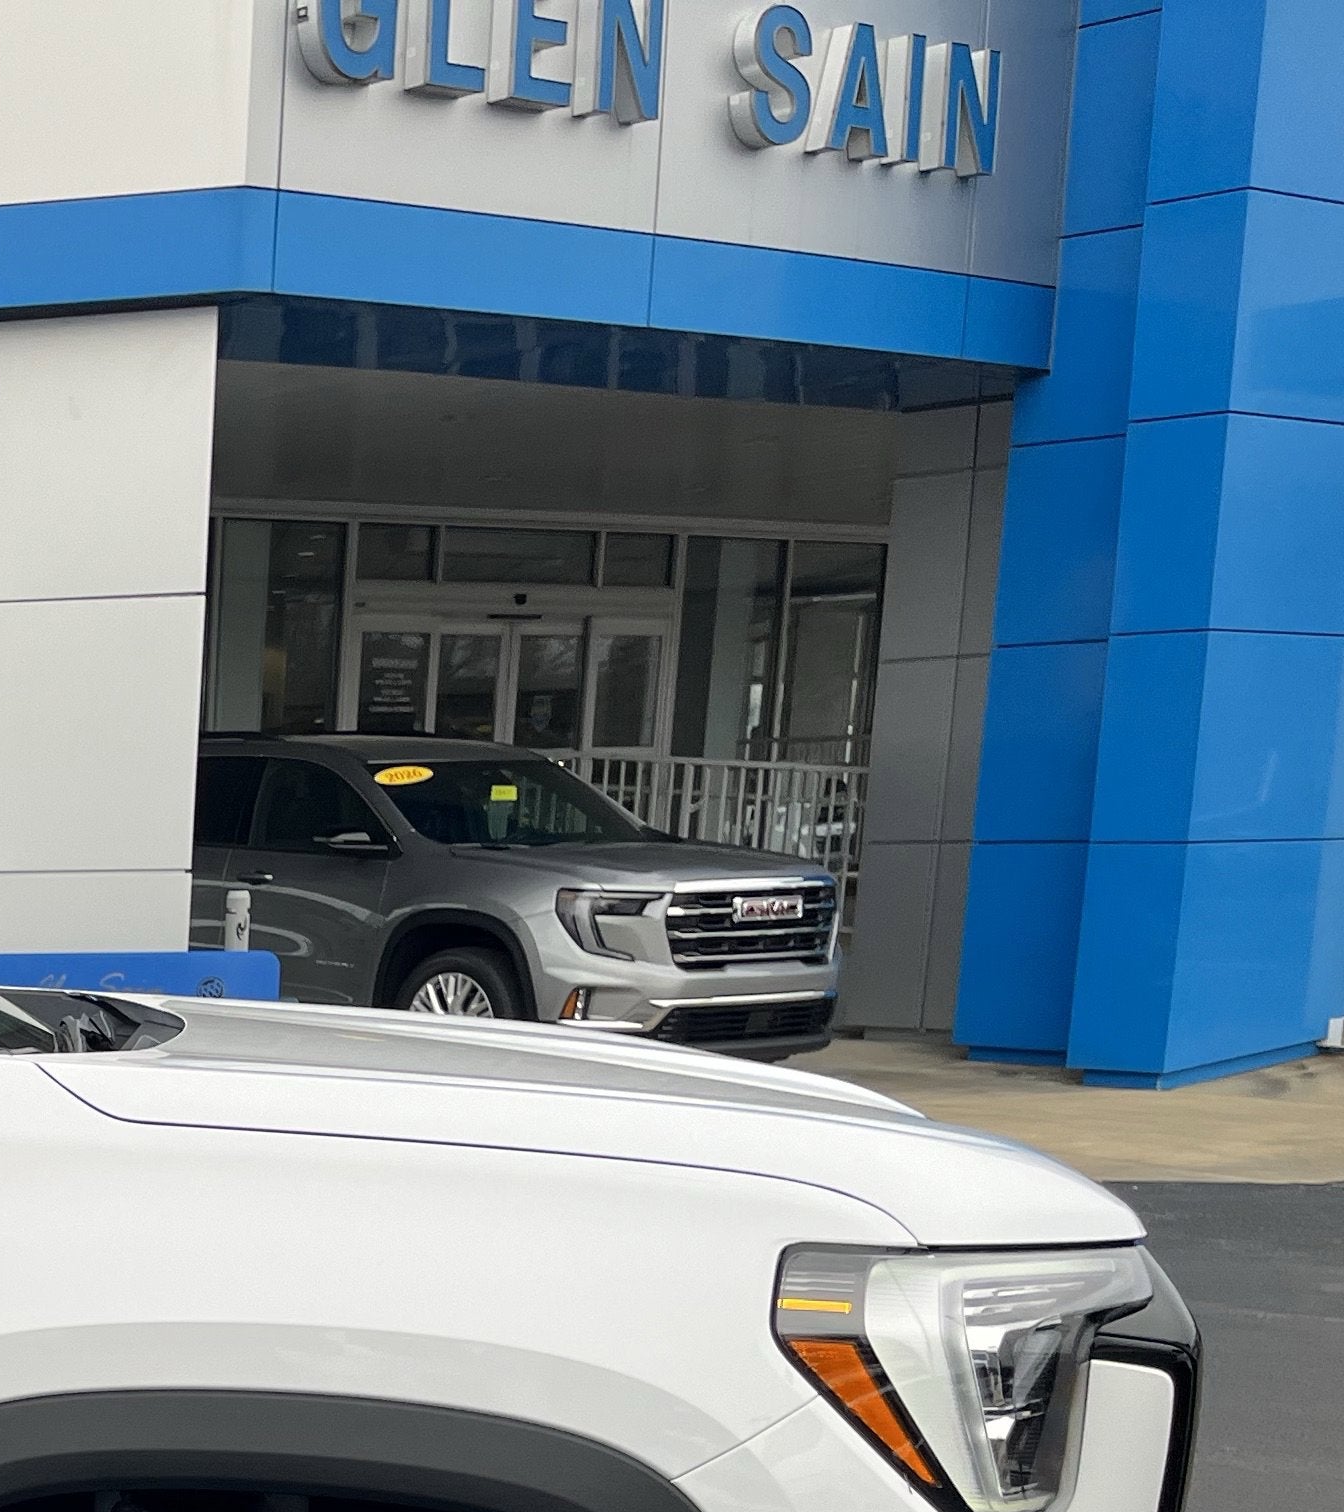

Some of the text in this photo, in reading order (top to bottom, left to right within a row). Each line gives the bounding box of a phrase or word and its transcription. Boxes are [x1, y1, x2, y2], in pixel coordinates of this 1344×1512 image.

[306, 0, 1001, 176] GLEN SAIN
[384, 769, 424, 782] 2026
